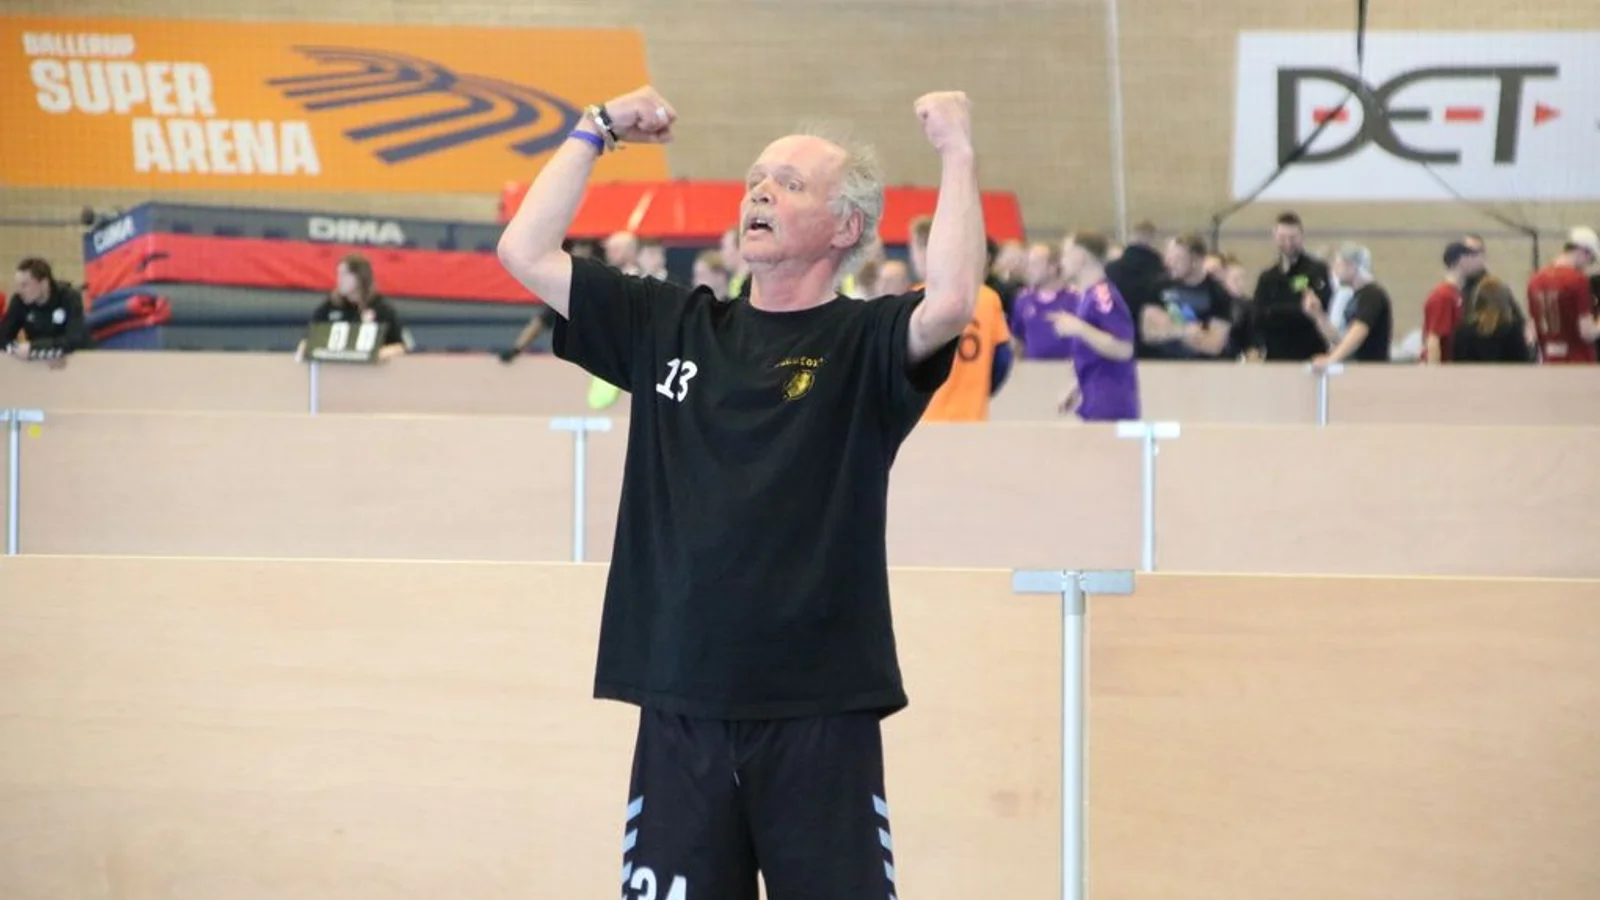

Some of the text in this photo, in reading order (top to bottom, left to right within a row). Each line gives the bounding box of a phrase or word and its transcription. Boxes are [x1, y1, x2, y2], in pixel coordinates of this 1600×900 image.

[31, 60, 216, 115] SUPER
[1277, 66, 1559, 164] DET
[132, 118, 321, 175] ARENA
[309, 217, 404, 244] DIMA
[656, 358, 698, 402] 13
